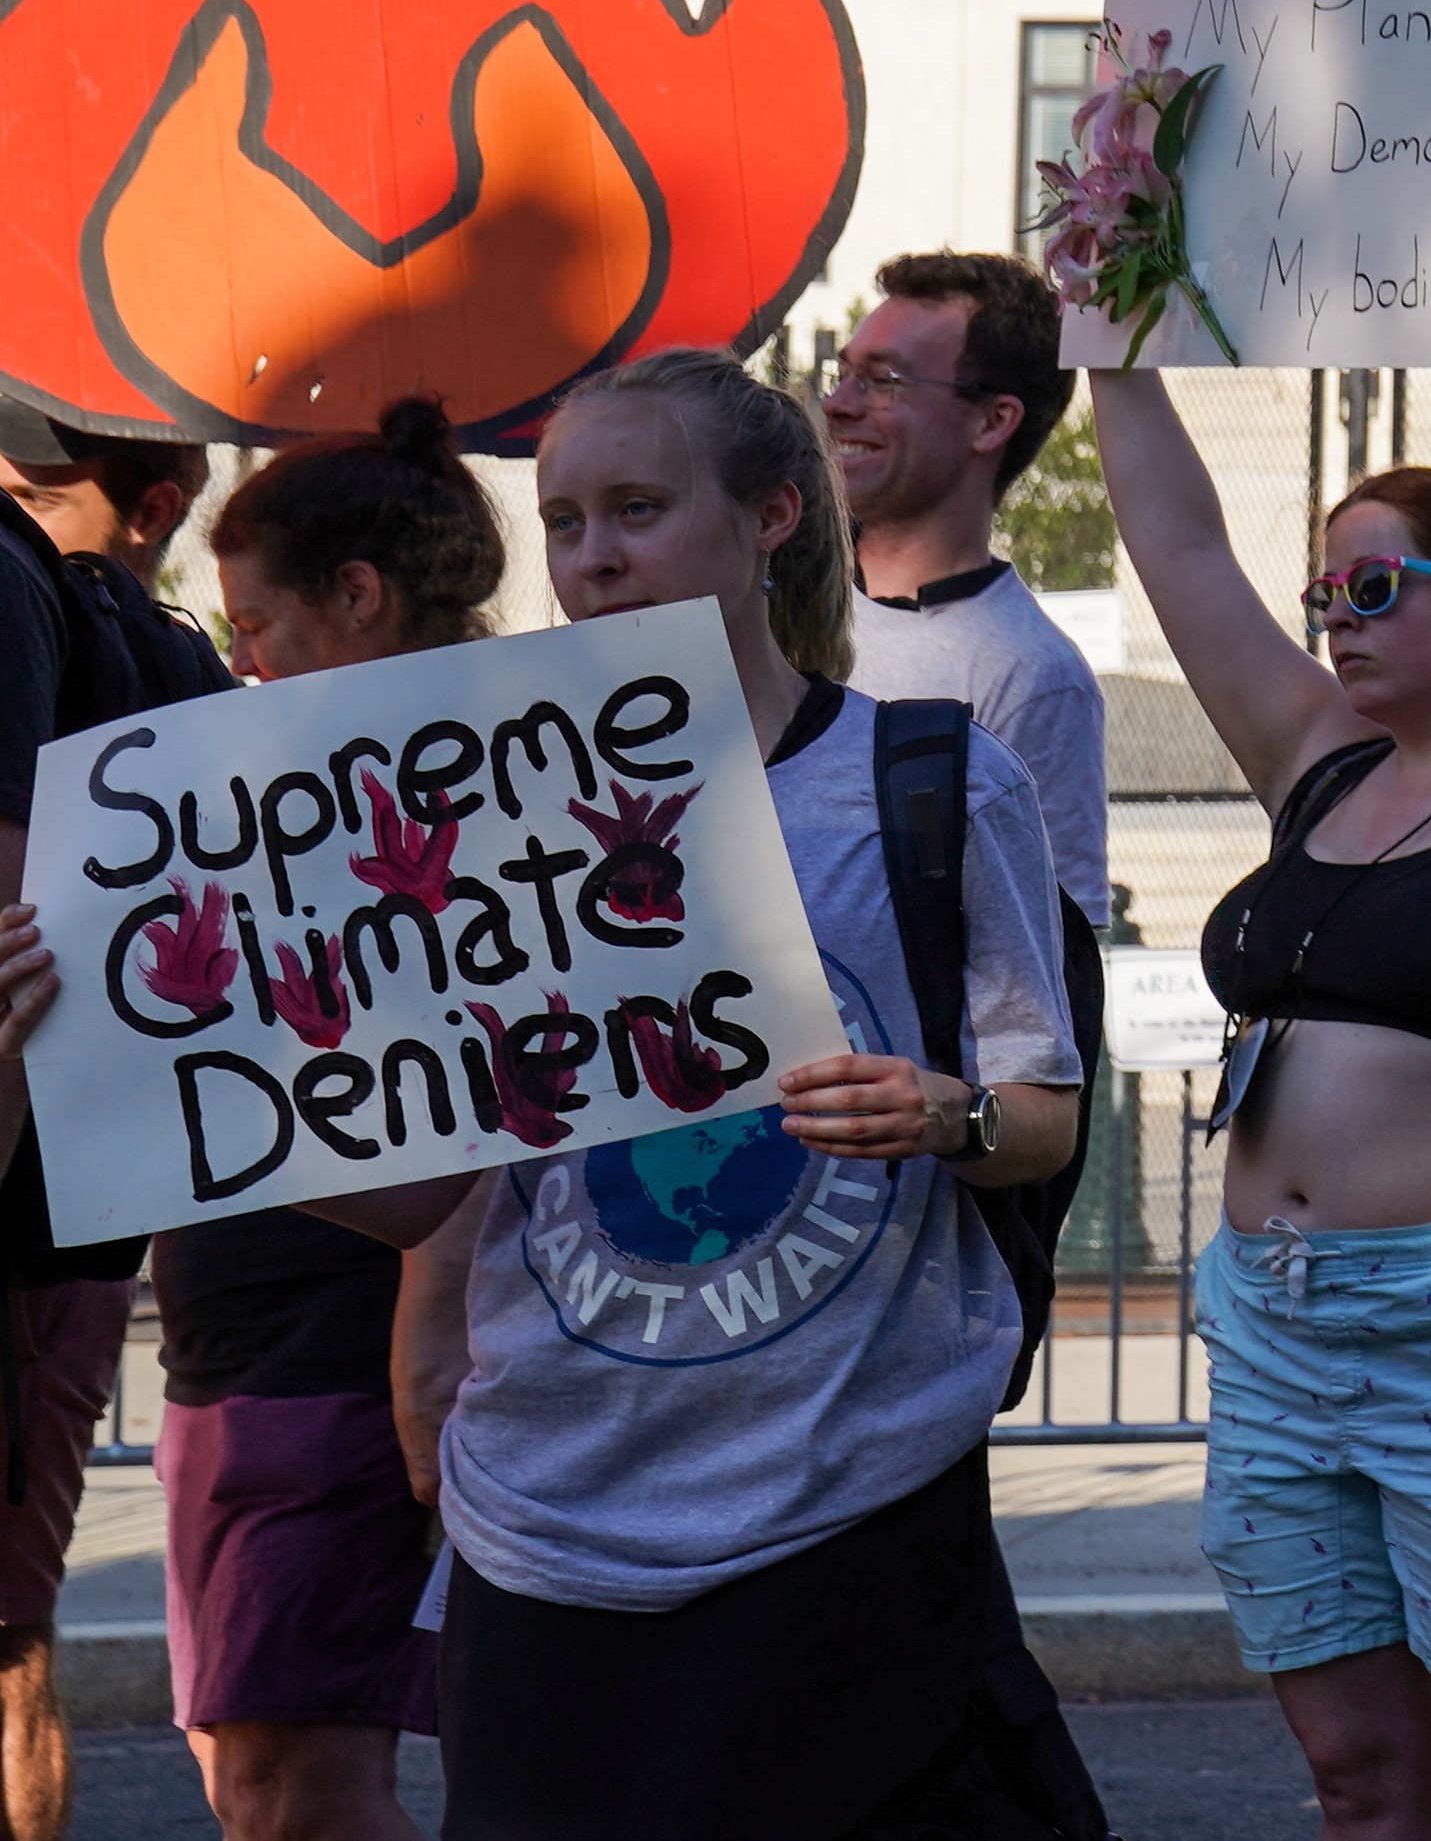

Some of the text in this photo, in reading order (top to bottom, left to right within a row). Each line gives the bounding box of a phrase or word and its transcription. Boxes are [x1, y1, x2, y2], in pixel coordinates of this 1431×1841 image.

[1236, 106, 1303, 219] My
[1260, 237, 1329, 352] My
[83, 675, 694, 916] Supreme
[105, 835, 686, 1041] Climate
[174, 970, 771, 1202] Deniers
[534, 1157, 879, 1344] CAN'T WAIT
